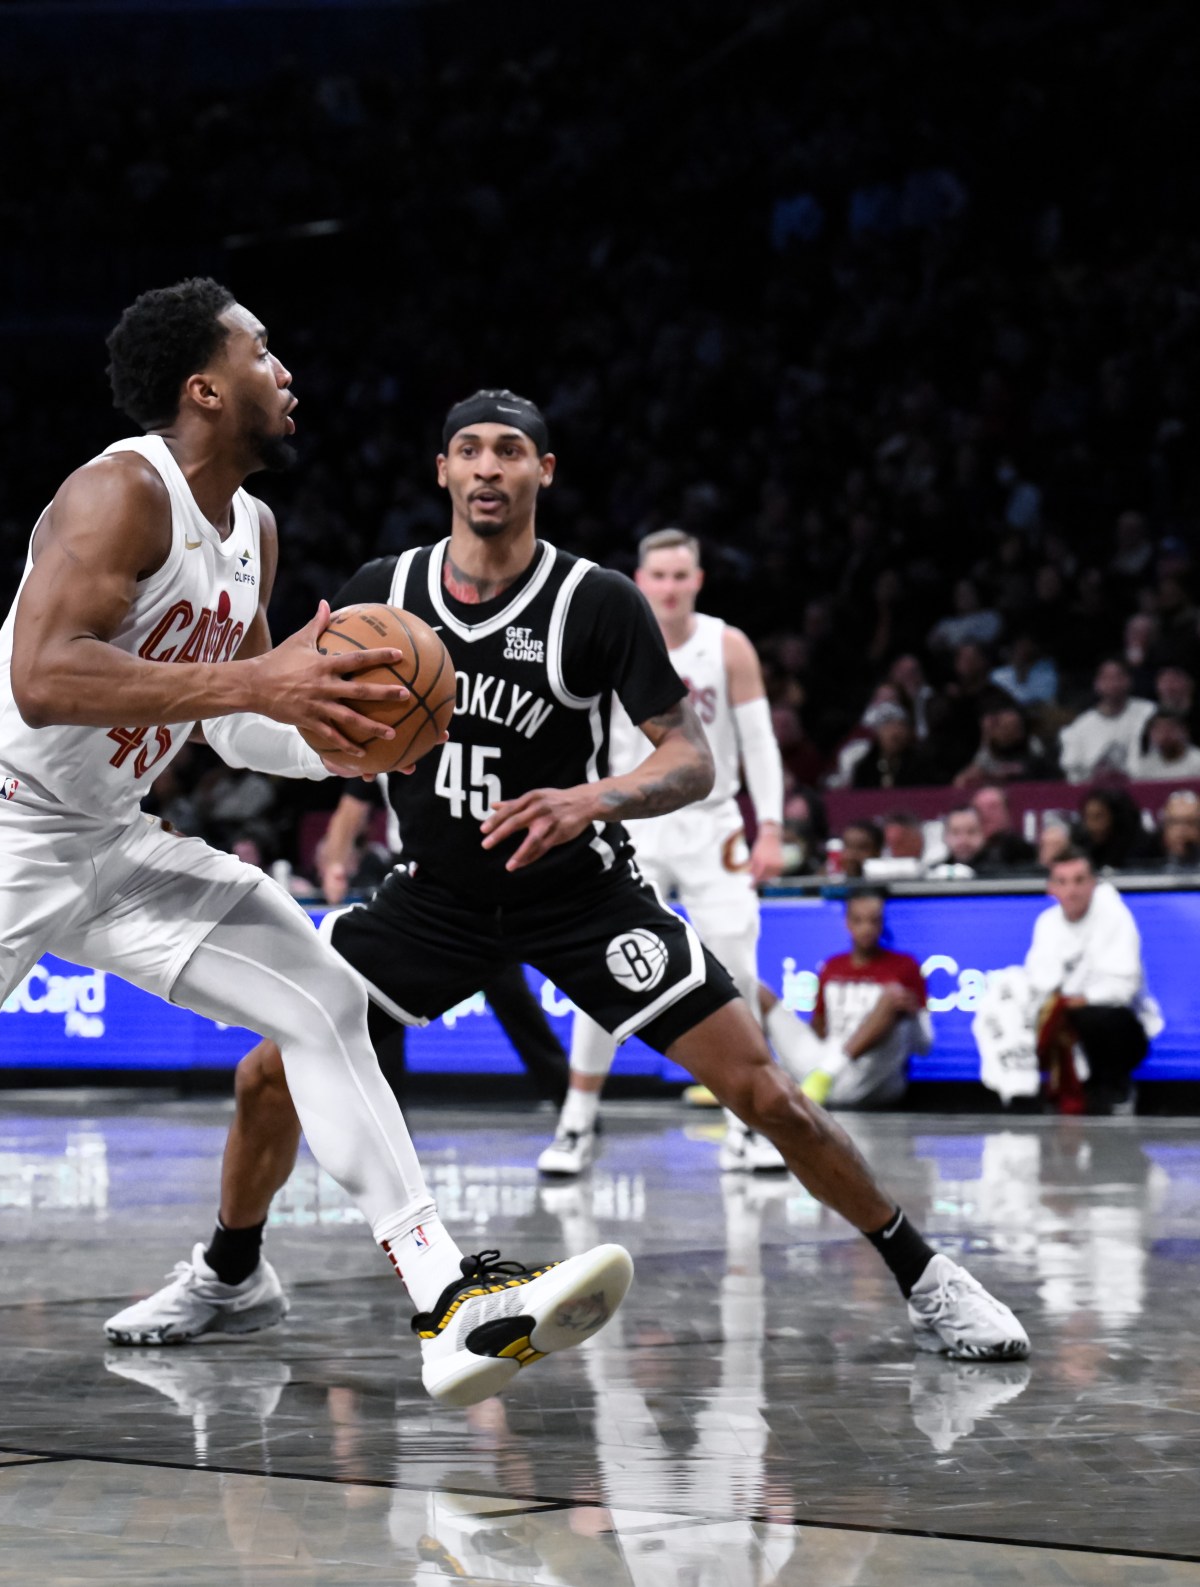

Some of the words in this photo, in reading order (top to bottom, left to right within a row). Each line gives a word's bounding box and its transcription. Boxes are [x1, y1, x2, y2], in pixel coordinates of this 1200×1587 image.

[235, 571, 255, 586] CLIFFS
[505, 626, 532, 639] GET
[505, 637, 544, 651] YOUR
[503, 648, 544, 663] GUIDE
[454, 671, 554, 739] OKLYN
[435, 742, 502, 822] 45
